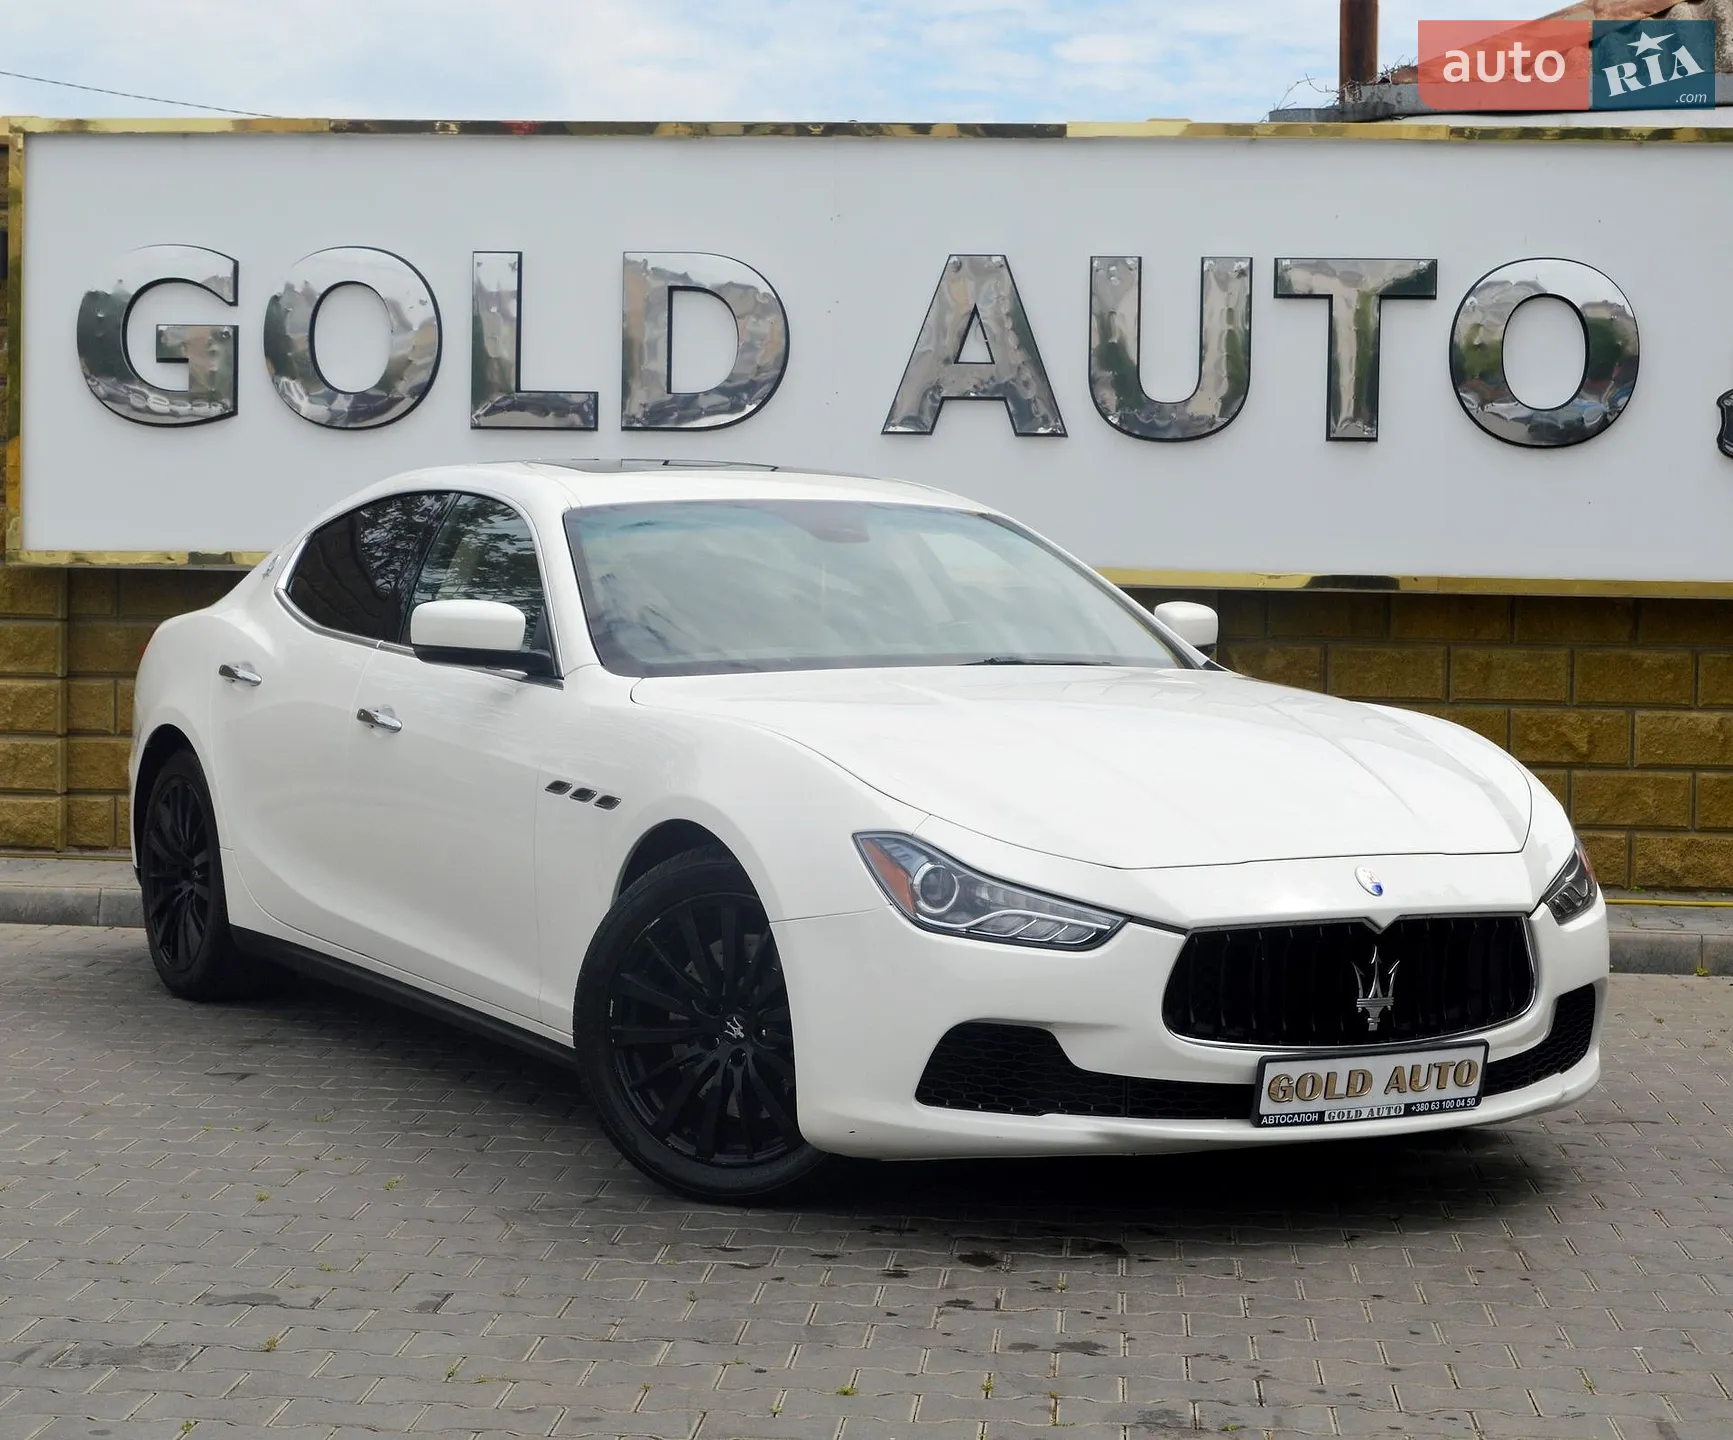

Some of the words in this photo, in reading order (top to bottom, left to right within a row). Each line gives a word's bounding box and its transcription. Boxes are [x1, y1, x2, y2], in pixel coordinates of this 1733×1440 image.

[77, 243, 790, 431] GOLD
[881, 254, 1640, 448] AUTO
[1267, 1068, 1374, 1103] GOLD
[1384, 1059, 1479, 1095] AUTO
[1327, 1109, 1363, 1121] GOLD
[1366, 1105, 1403, 1118] AUTO
[1412, 1103, 1429, 1112] +380
[1431, 1102, 1440, 1110] 63
[1442, 1100, 1454, 1109] 100
[1456, 1099, 1465, 1107] 04
[1467, 1098, 1475, 1106] 50
[1261, 1112, 1319, 1125] АВТОСАЛОН
